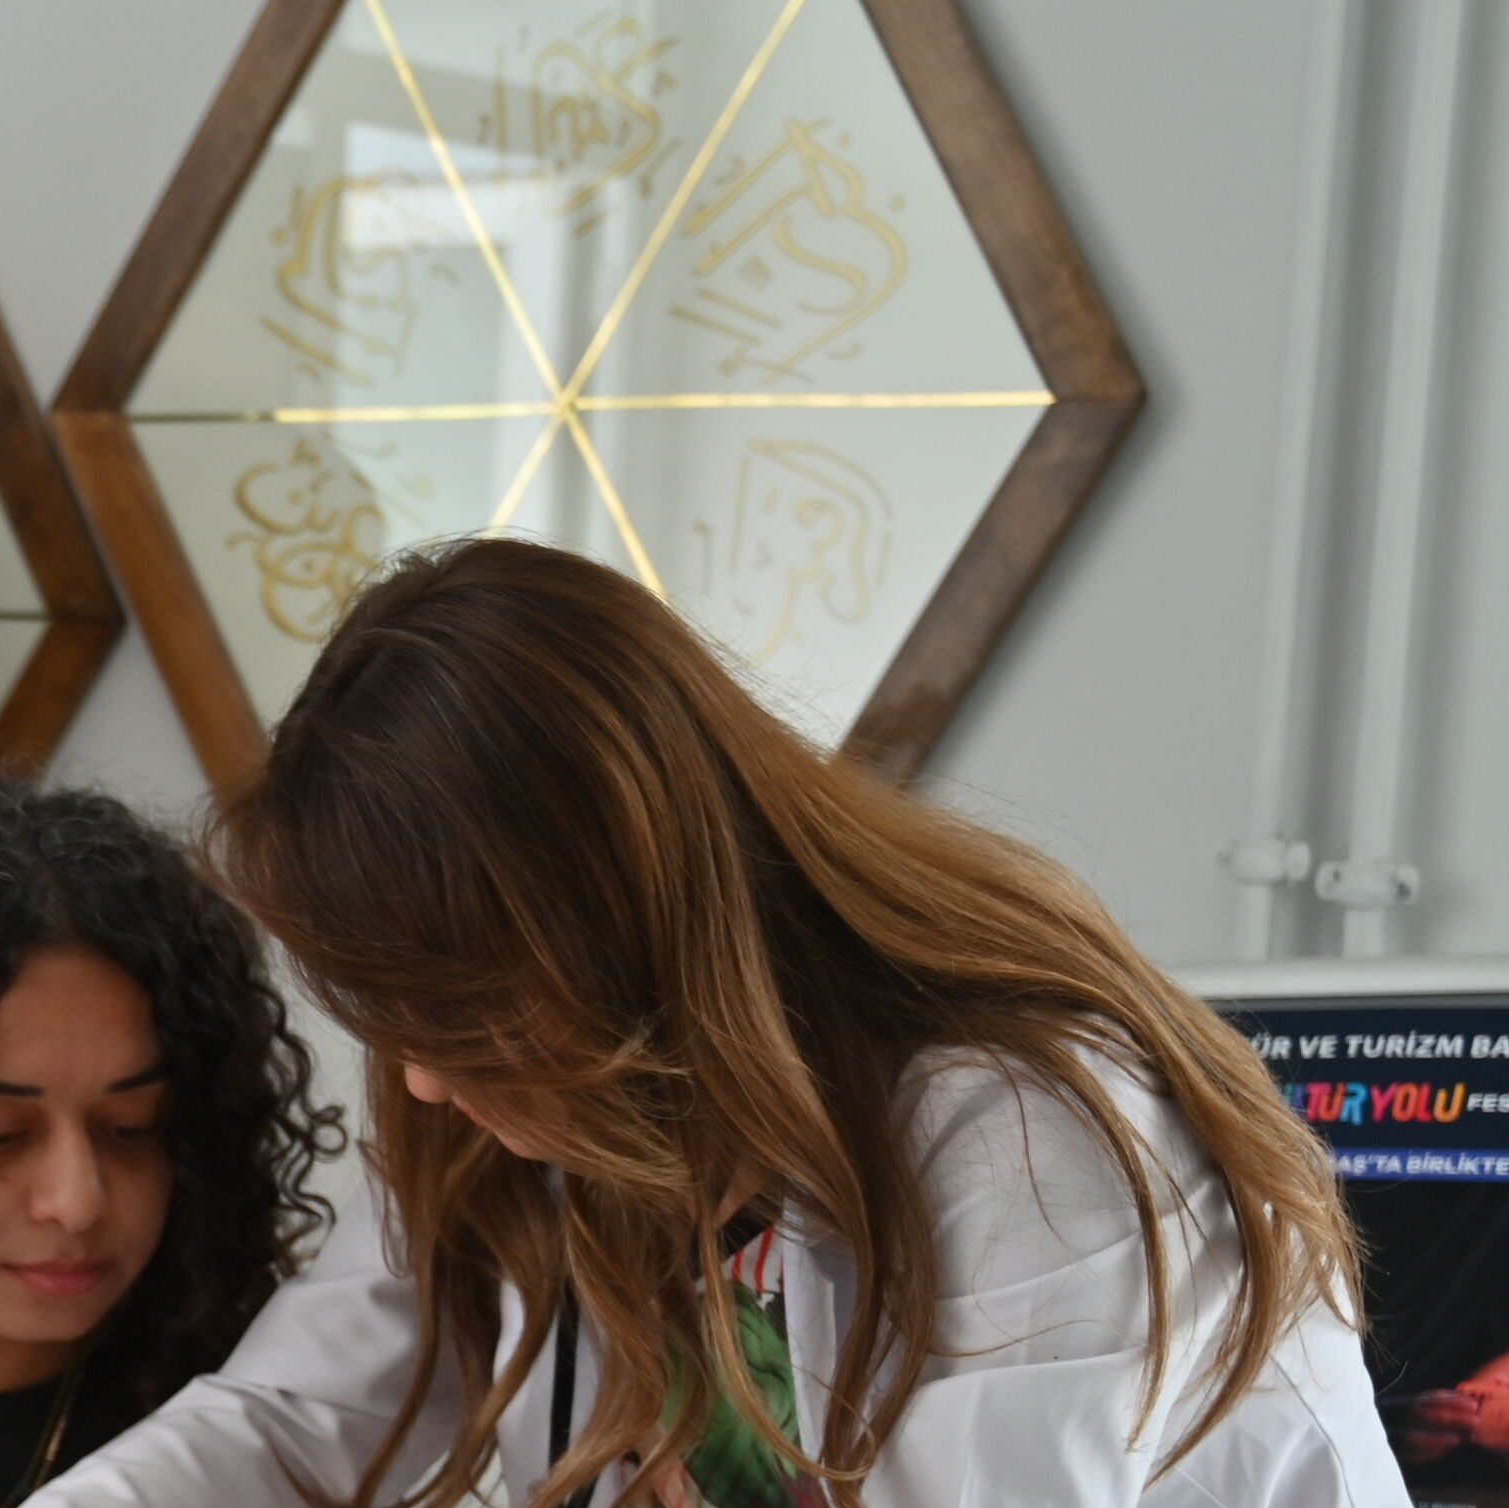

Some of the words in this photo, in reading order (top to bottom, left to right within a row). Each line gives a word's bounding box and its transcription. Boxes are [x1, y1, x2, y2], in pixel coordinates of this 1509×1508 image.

[1299, 1035, 1337, 1059] VE
[1345, 1030, 1464, 1059] TURİZM
[1470, 1034, 1509, 1059] BA
[1370, 1082, 1466, 1123] YOLU
